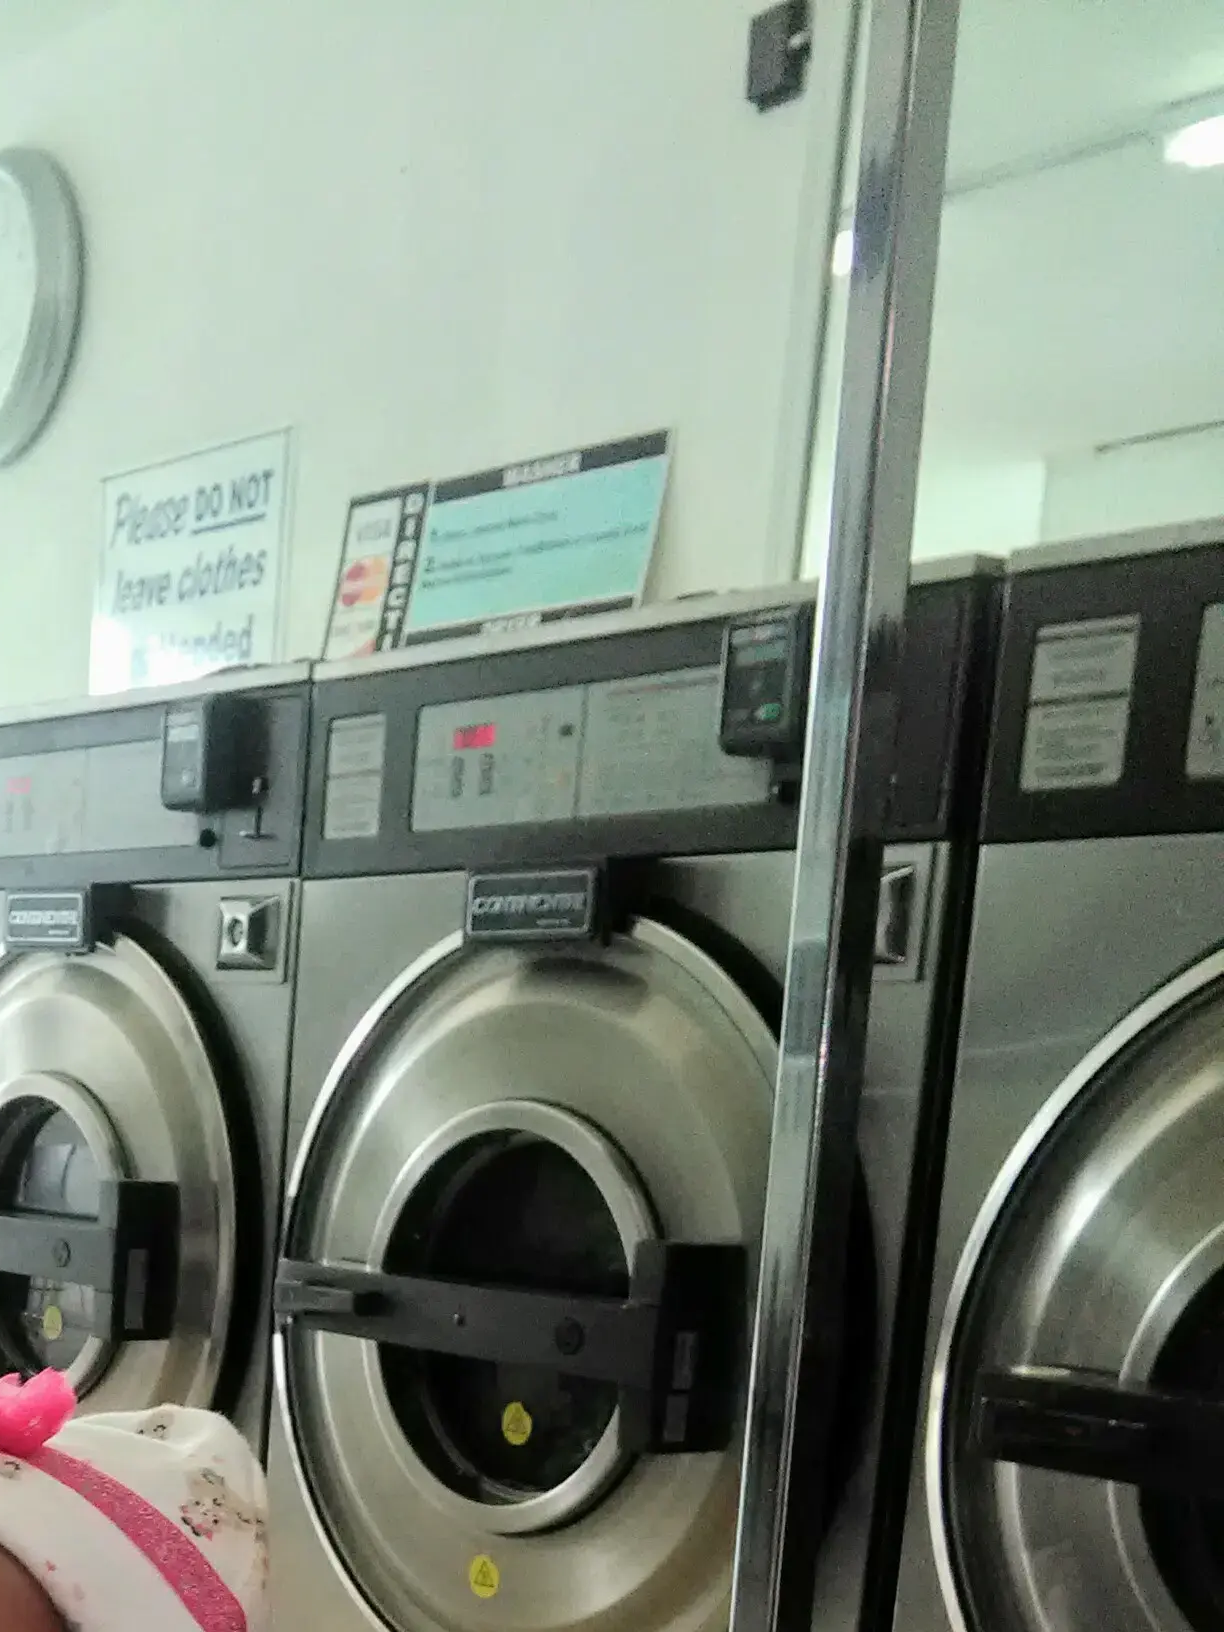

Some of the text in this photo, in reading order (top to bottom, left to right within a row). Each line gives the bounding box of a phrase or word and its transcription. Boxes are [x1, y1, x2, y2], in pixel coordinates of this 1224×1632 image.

[110, 468, 274, 549] Please DO NOT
[113, 544, 267, 614] leave clothes
